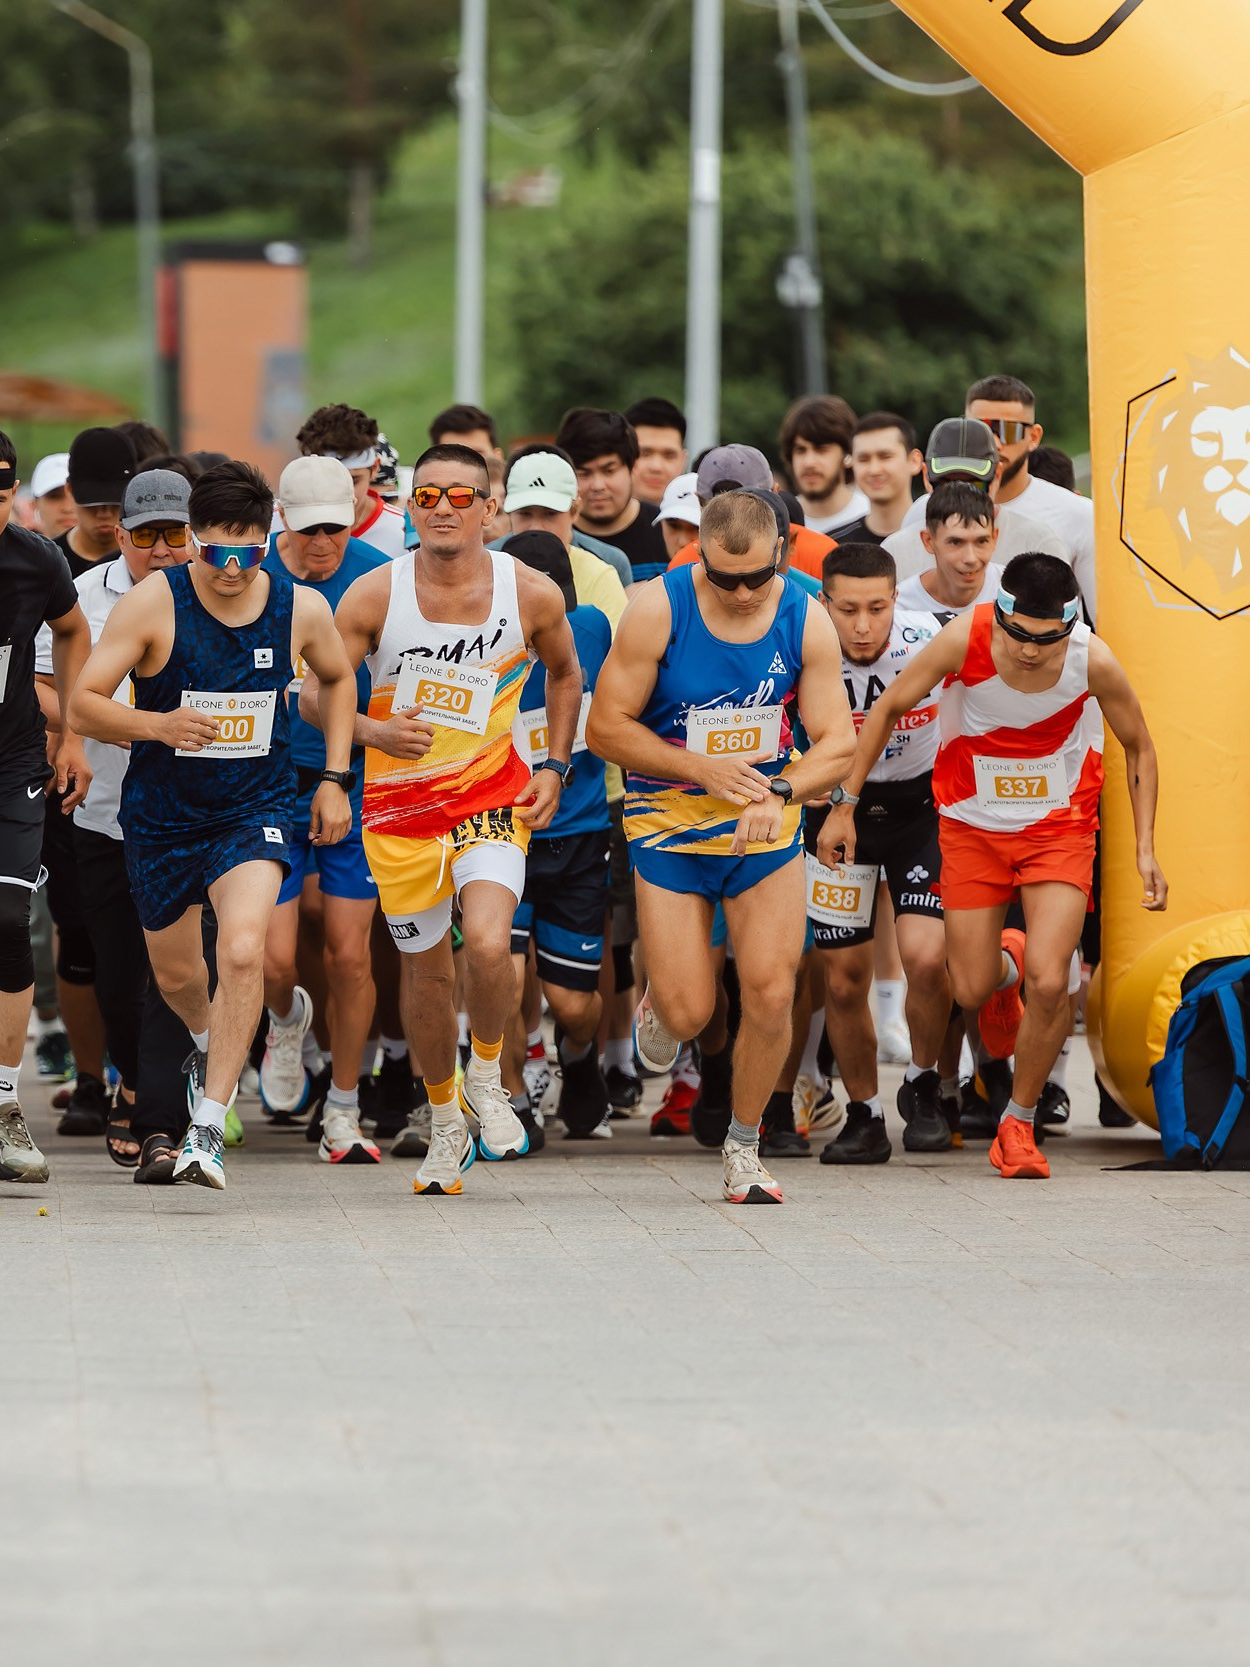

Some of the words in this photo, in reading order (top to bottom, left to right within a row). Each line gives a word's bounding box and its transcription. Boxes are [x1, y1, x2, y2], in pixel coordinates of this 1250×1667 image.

[409, 664, 443, 677] LEONE
[459, 673, 488, 687] D'ORO
[190, 700, 223, 709] LEONE
[240, 700, 268, 709] D'ORO
[421, 684, 466, 710] 320
[401, 704, 461, 722] БЛАВОРИТЕЛЬНЫЙ
[696, 717, 730, 726] LEONE
[745, 712, 774, 722] D'ORO
[214, 719, 249, 740] 00
[192, 744, 246, 752] ТВОРИТЕЛЬНЫЙ
[712, 731, 755, 752] 360
[981, 763, 1012, 771] LEONE
[1028, 762, 1057, 771] D'ORO
[1000, 778, 1041, 796] 337
[816, 884, 856, 909] 338
[900, 892, 944, 909] Emira
[814, 924, 855, 940] irates
